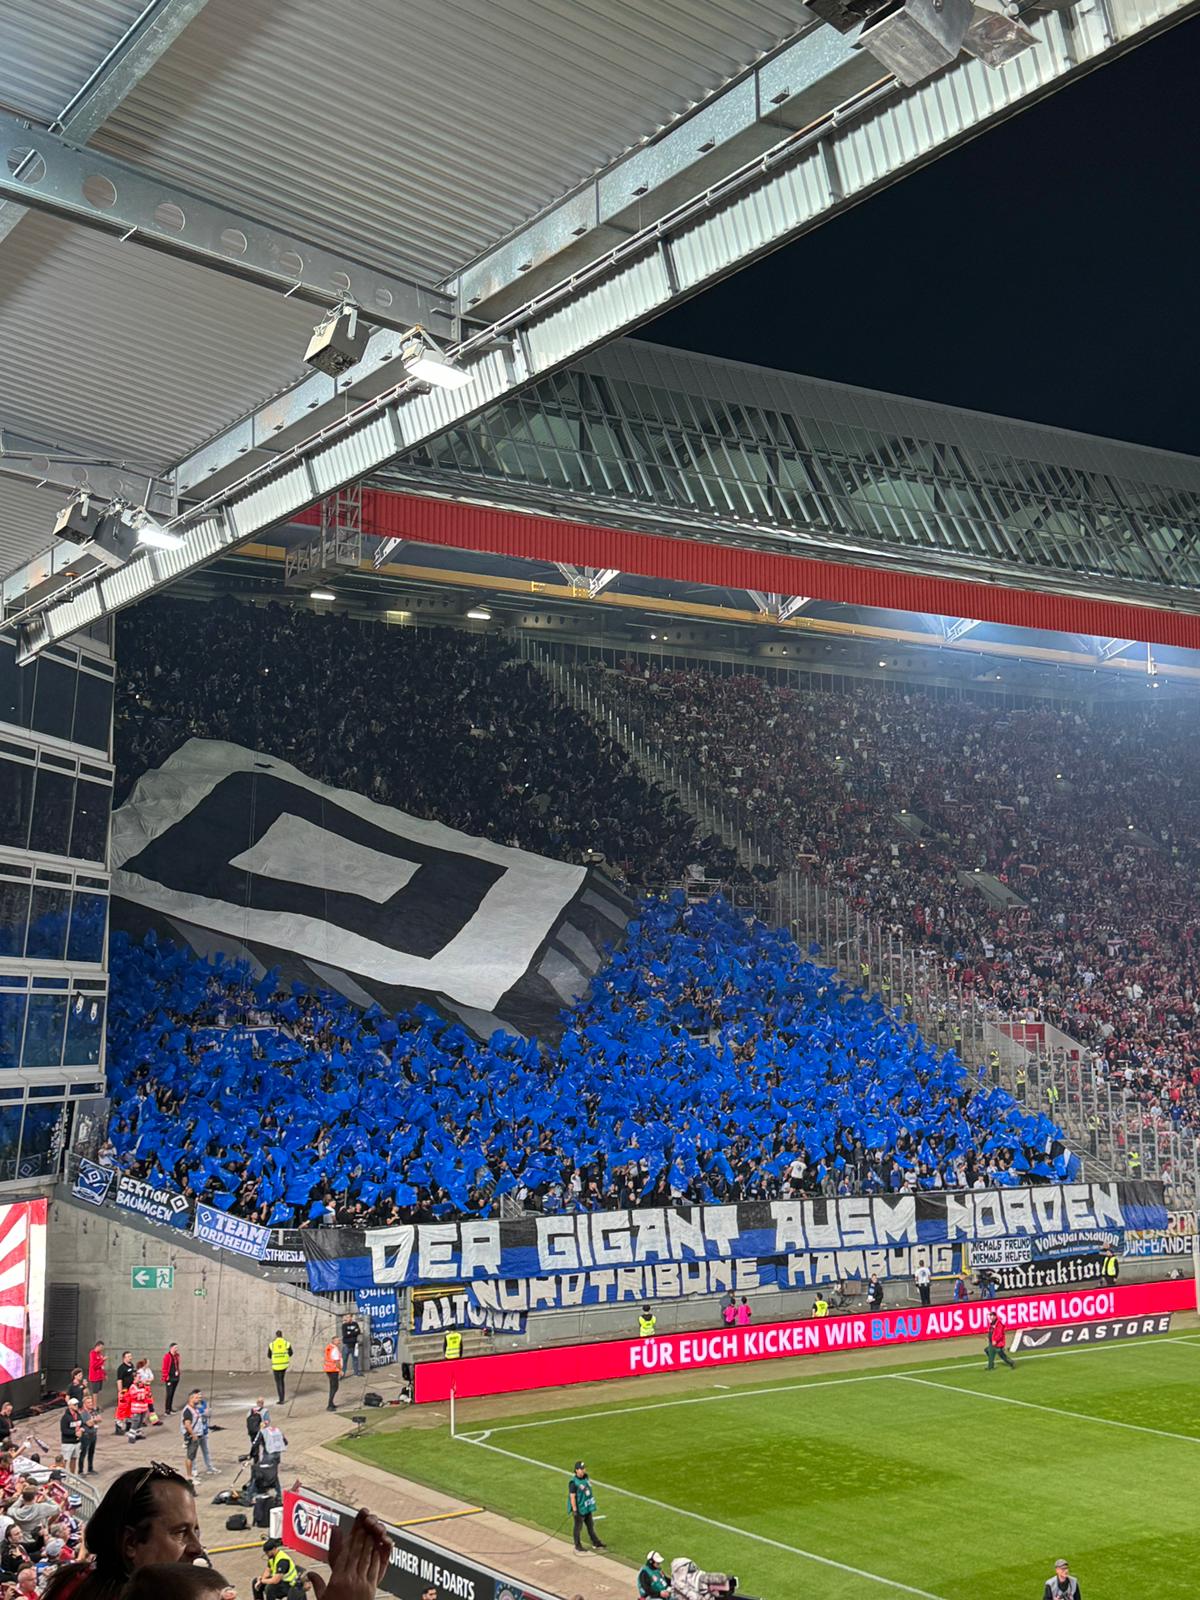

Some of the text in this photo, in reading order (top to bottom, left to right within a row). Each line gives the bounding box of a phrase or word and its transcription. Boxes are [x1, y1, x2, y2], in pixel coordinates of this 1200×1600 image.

[116, 1190, 174, 1222] BAUWAGEN
[120, 1176, 170, 1205] SEKTION
[198, 1223, 263, 1257] ORDHEIDE
[215, 1213, 266, 1245] TEAM
[365, 1182, 1126, 1284] DER GIGANT AUSM NORDEN
[972, 1240, 1003, 1253] NIEMALS
[972, 1252, 1003, 1265] NIEMALS
[787, 1243, 954, 1287] HAMBURG
[421, 1294, 521, 1331] ALTONA
[630, 1292, 1115, 1370] FÜR EUCH KICKEN WIR BLAU AUS UNSEREM LOGO!
[1060, 1317, 1170, 1343] CASTORE
[388, 1543, 476, 1600] ÜHRER IM E-DARTS
